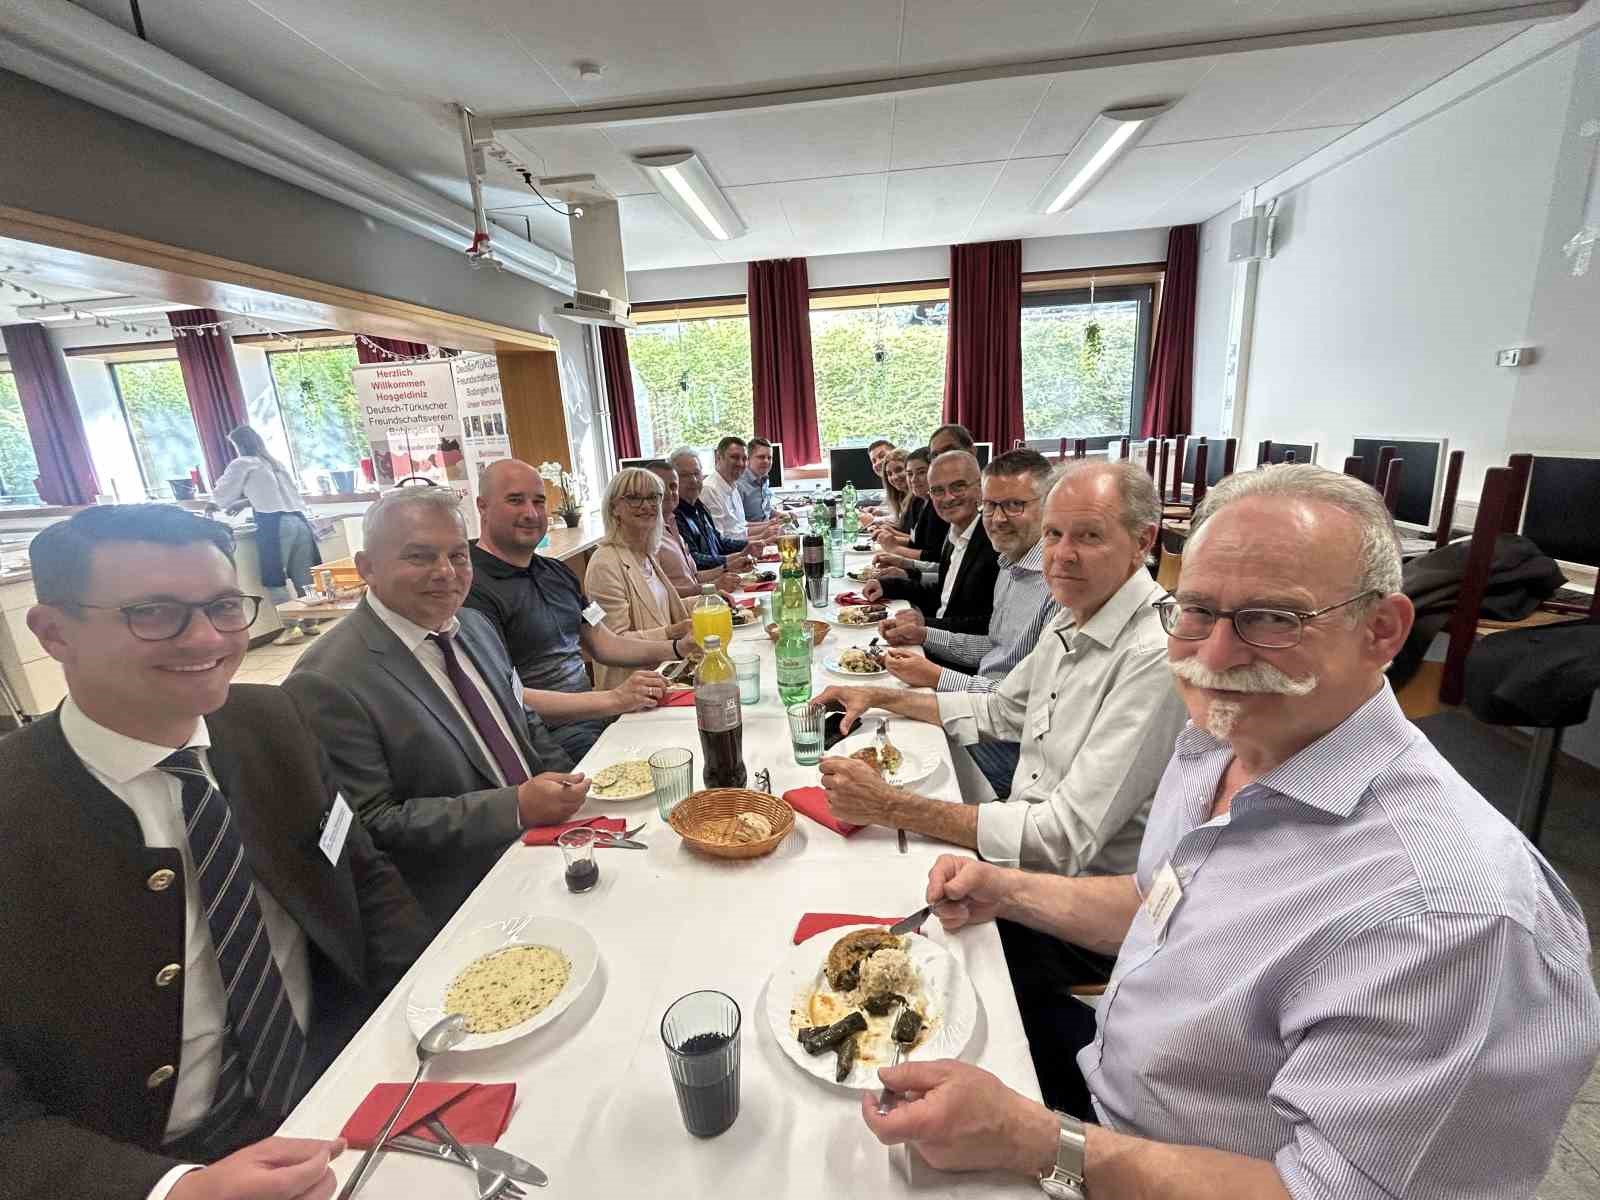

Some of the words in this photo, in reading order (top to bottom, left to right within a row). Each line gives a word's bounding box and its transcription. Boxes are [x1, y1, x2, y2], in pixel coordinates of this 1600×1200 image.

[376, 368, 413, 377] Herzlich
[371, 380, 426, 390] Willkommen
[366, 402, 448, 415] Deutsch-Türkischer
[368, 414, 454, 425] Freundschaftsverein
